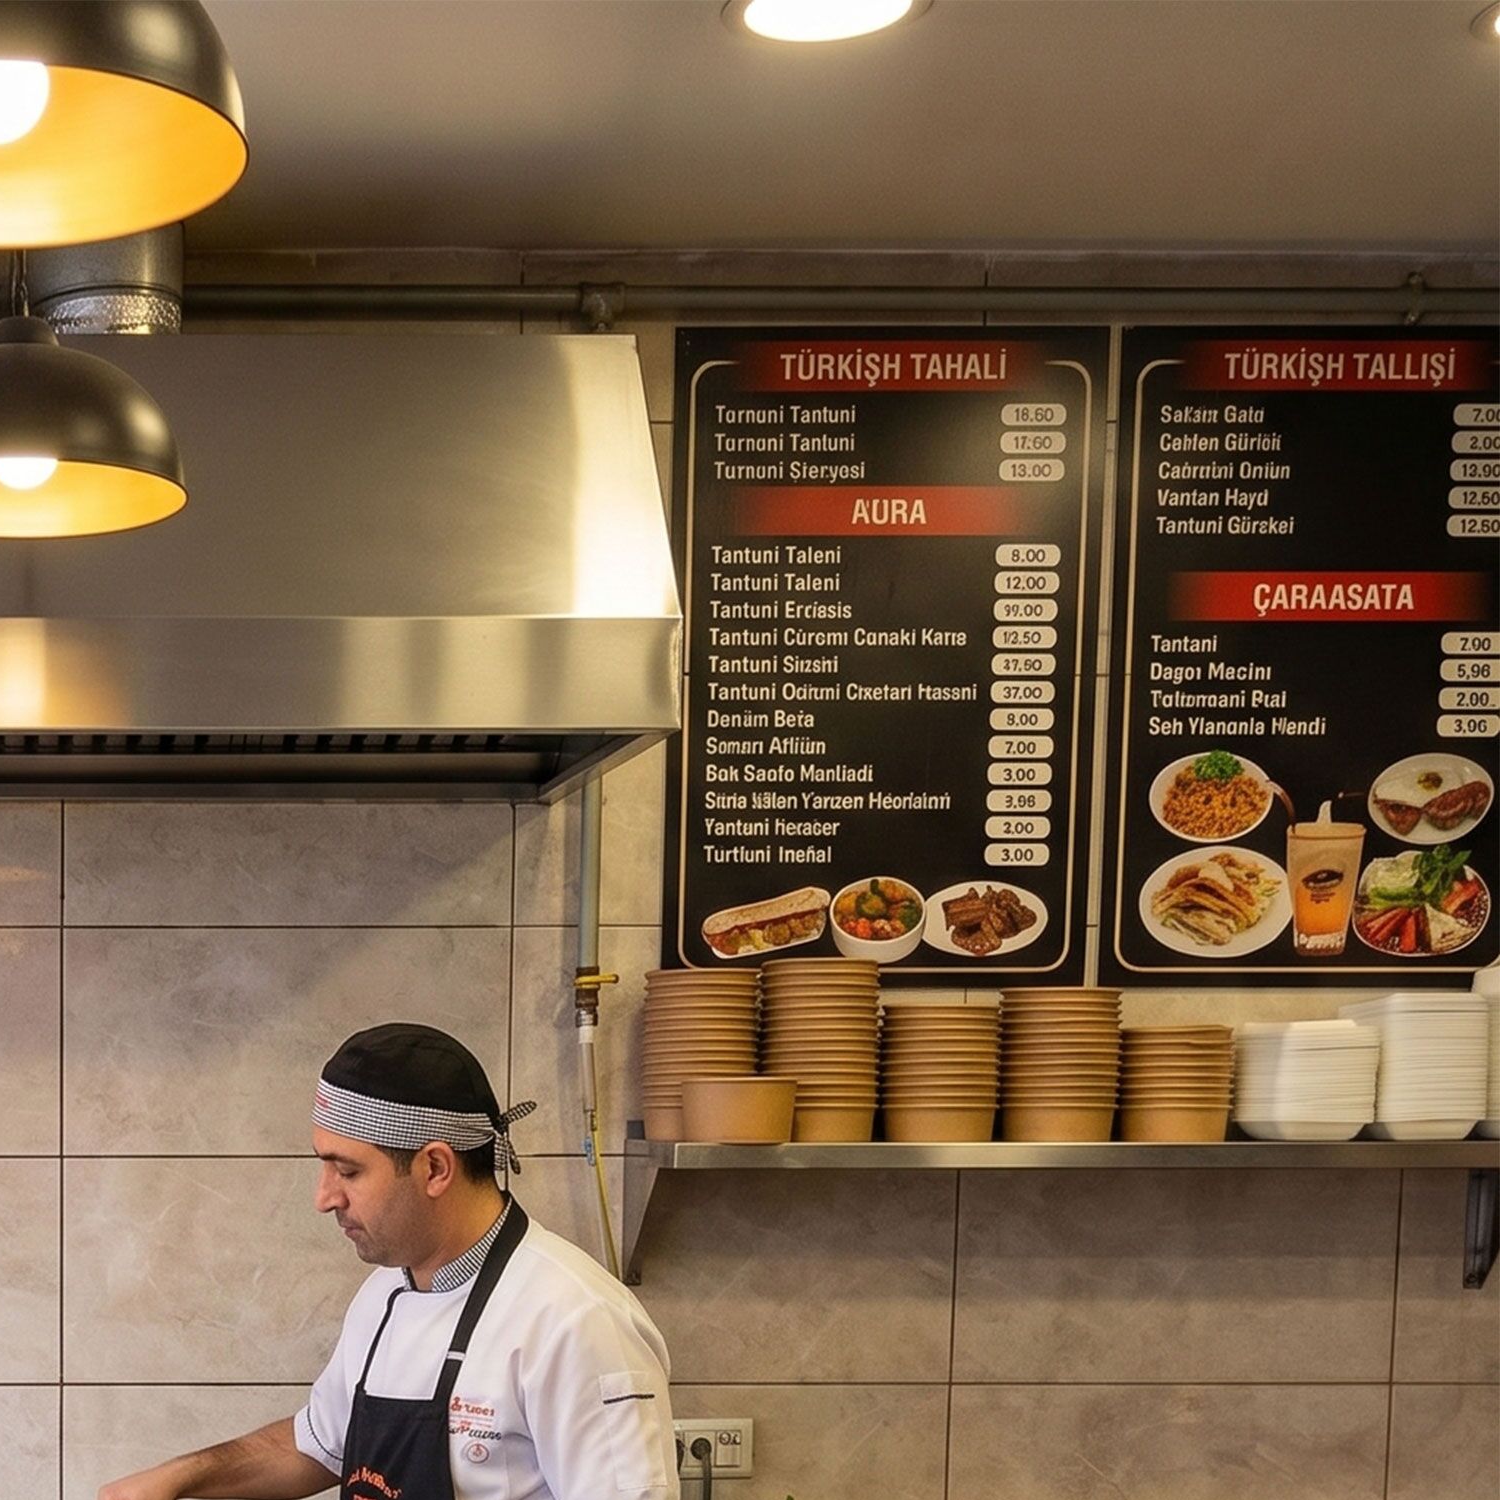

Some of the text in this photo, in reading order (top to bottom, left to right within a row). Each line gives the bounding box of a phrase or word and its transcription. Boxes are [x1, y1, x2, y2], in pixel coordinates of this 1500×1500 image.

[780, 348, 1007, 388] TÜRKİŞH TAHALİ
[1224, 347, 1456, 387] TÜRKİŞH TALLIŞİ
[789, 404, 856, 424] Tantuni
[789, 433, 855, 452] Tantuni
[1011, 463, 1052, 478] 13.00
[1156, 516, 1223, 535] Tantuni
[711, 545, 1046, 564] Tantuni Taleni 8.00
[710, 573, 779, 592] Tantuni
[784, 573, 840, 592] Taleni
[1253, 582, 1415, 617] ÇARAASATA
[709, 600, 778, 619] Tantuni
[709, 627, 778, 646] Tantuni
[1150, 634, 1218, 653] Tantani
[708, 655, 778, 673] Tantuni
[708, 682, 776, 701] Tantuni
[1002, 686, 1043, 700] 37.00
[1004, 741, 1037, 755] 7.00
[1001, 848, 1034, 862] 3.00
